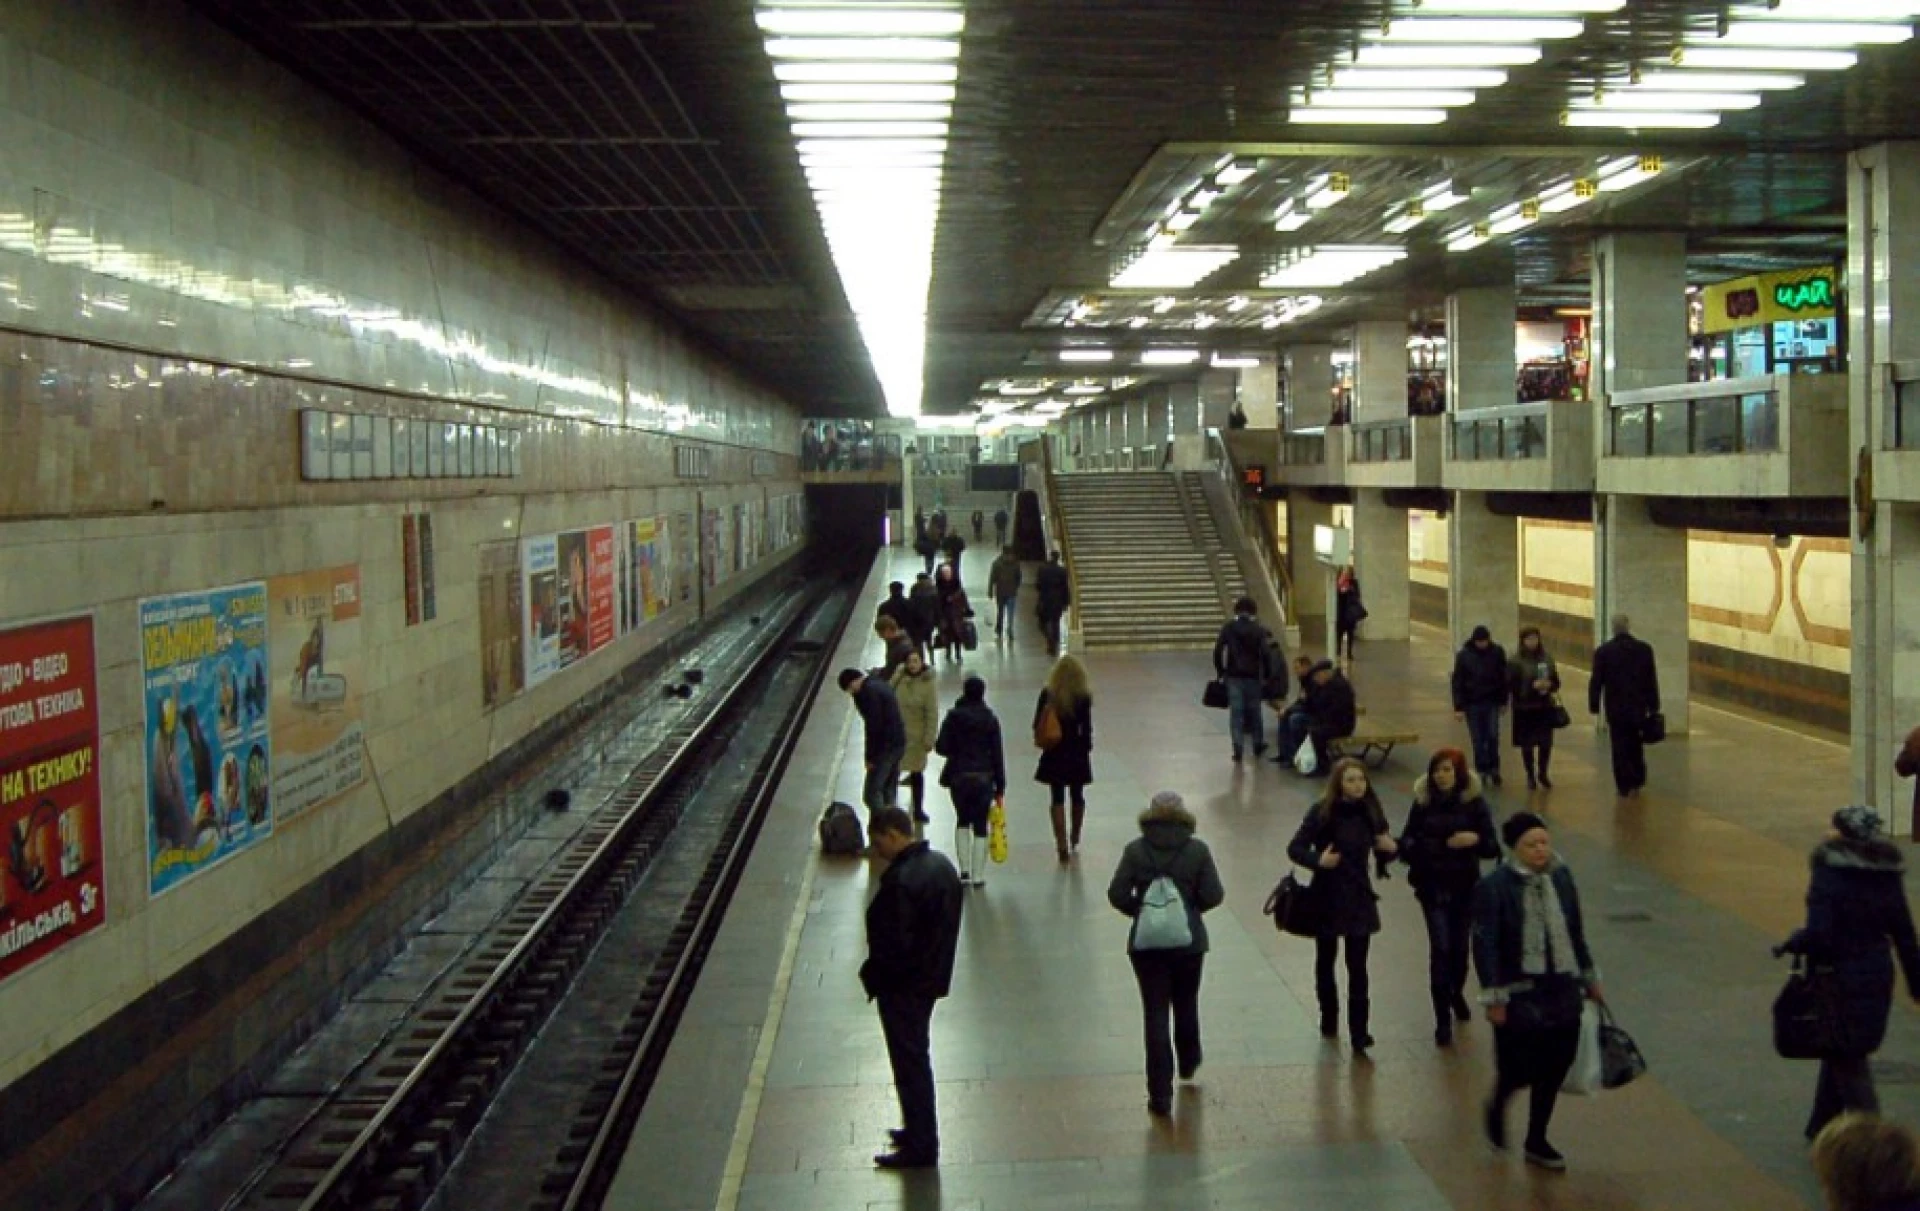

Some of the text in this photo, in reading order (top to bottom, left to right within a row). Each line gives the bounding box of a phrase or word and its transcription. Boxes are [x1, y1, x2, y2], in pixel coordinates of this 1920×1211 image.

[32, 652, 68, 684] ВІДЕО
[36, 688, 84, 721] ТЕХНІКА
[1, 747, 92, 804] НА ТЕХНІКУ!
